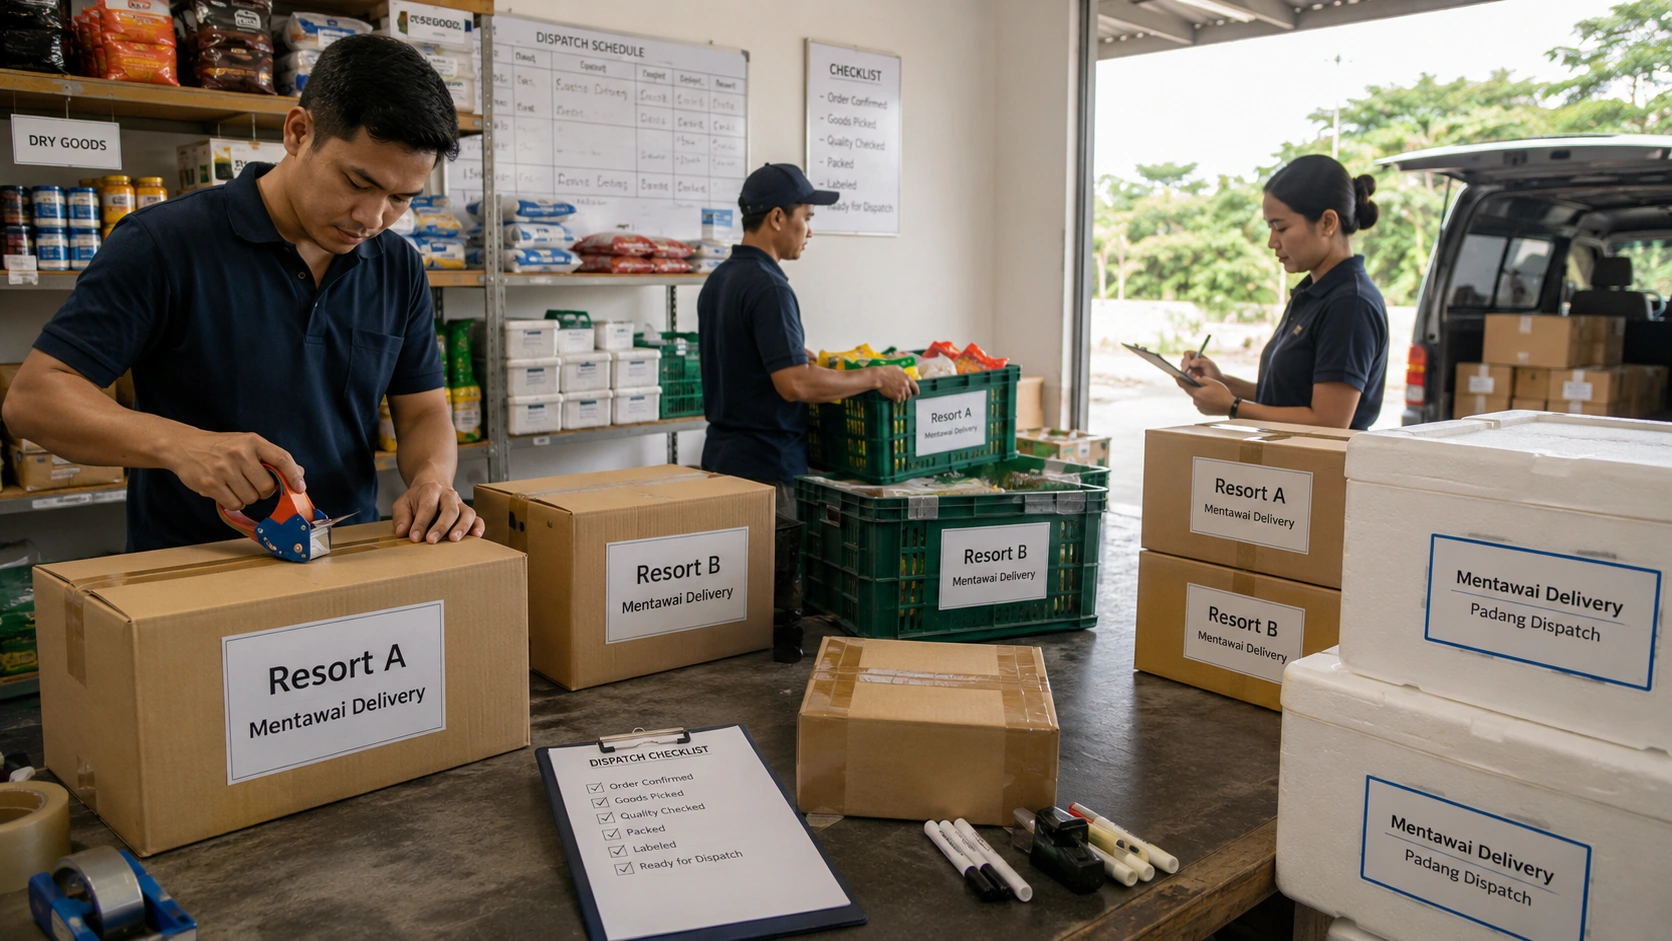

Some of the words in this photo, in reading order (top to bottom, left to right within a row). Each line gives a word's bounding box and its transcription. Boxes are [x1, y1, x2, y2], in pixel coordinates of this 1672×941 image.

[536, 31, 589, 49] DISPATCH
[592, 40, 644, 58] SCHEDULE
[829, 63, 882, 81] CHECKLIST
[827, 92, 849, 104] Order
[850, 95, 887, 109] Confirmed
[827, 113, 852, 126] Goods
[852, 116, 876, 129] Picked
[29, 135, 56, 147] DRY
[60, 137, 107, 151] GOODS
[827, 134, 853, 150] Quality
[854, 137, 885, 151] Checked
[827, 156, 854, 169] Packed
[827, 179, 857, 190] Labeled
[851, 200, 862, 212] for
[863, 201, 893, 214] Dispatch
[931, 410, 962, 423] Resort
[964, 407, 972, 418] A
[924, 430, 953, 439] Mentawai
[954, 425, 978, 435] Delivery
[1215, 478, 1268, 501] Resort
[1273, 487, 1285, 504] A
[1204, 503, 1251, 520] Mentawai
[1253, 511, 1295, 530] Delivery
[964, 547, 1013, 564] Resort
[1018, 544, 1027, 559] B
[637, 559, 702, 585] Resort
[708, 555, 720, 574] B
[952, 573, 997, 587] Mentawai
[1000, 571, 1036, 582] Delivery
[622, 592, 682, 614] Mentawai
[686, 588, 734, 604] Delivery
[1457, 570, 1540, 599] Mentawai
[1546, 586, 1623, 618] Delivery
[1209, 606, 1261, 634] Resort
[1267, 620, 1278, 637] B
[1471, 602, 1526, 629] Padang
[1531, 615, 1600, 642] Dispatch
[1198, 630, 1244, 651] Mentawai
[1246, 643, 1288, 665] Delivery
[269, 651, 374, 695] Resort
[384, 644, 406, 671] A
[250, 701, 345, 739] Mentawai
[353, 687, 425, 715] Delivery
[589, 753, 646, 767] DISPATCH
[648, 745, 708, 759] CHECKLIST
[609, 781, 638, 790] Order
[641, 773, 694, 786] Confirmed
[615, 795, 648, 804] Goods
[650, 790, 684, 800] Picked
[620, 810, 658, 820] Quality
[660, 803, 706, 815] Checked
[626, 824, 666, 836] Packed
[633, 840, 677, 853] Labeled
[1390, 813, 1473, 856] Mentawai
[1477, 844, 1555, 885] Delivery
[639, 859, 673, 870] Ready
[676, 857, 692, 865] for
[695, 850, 743, 863] Dispatch
[1404, 848, 1460, 882] Padang
[1463, 870, 1533, 907] Dispatch
